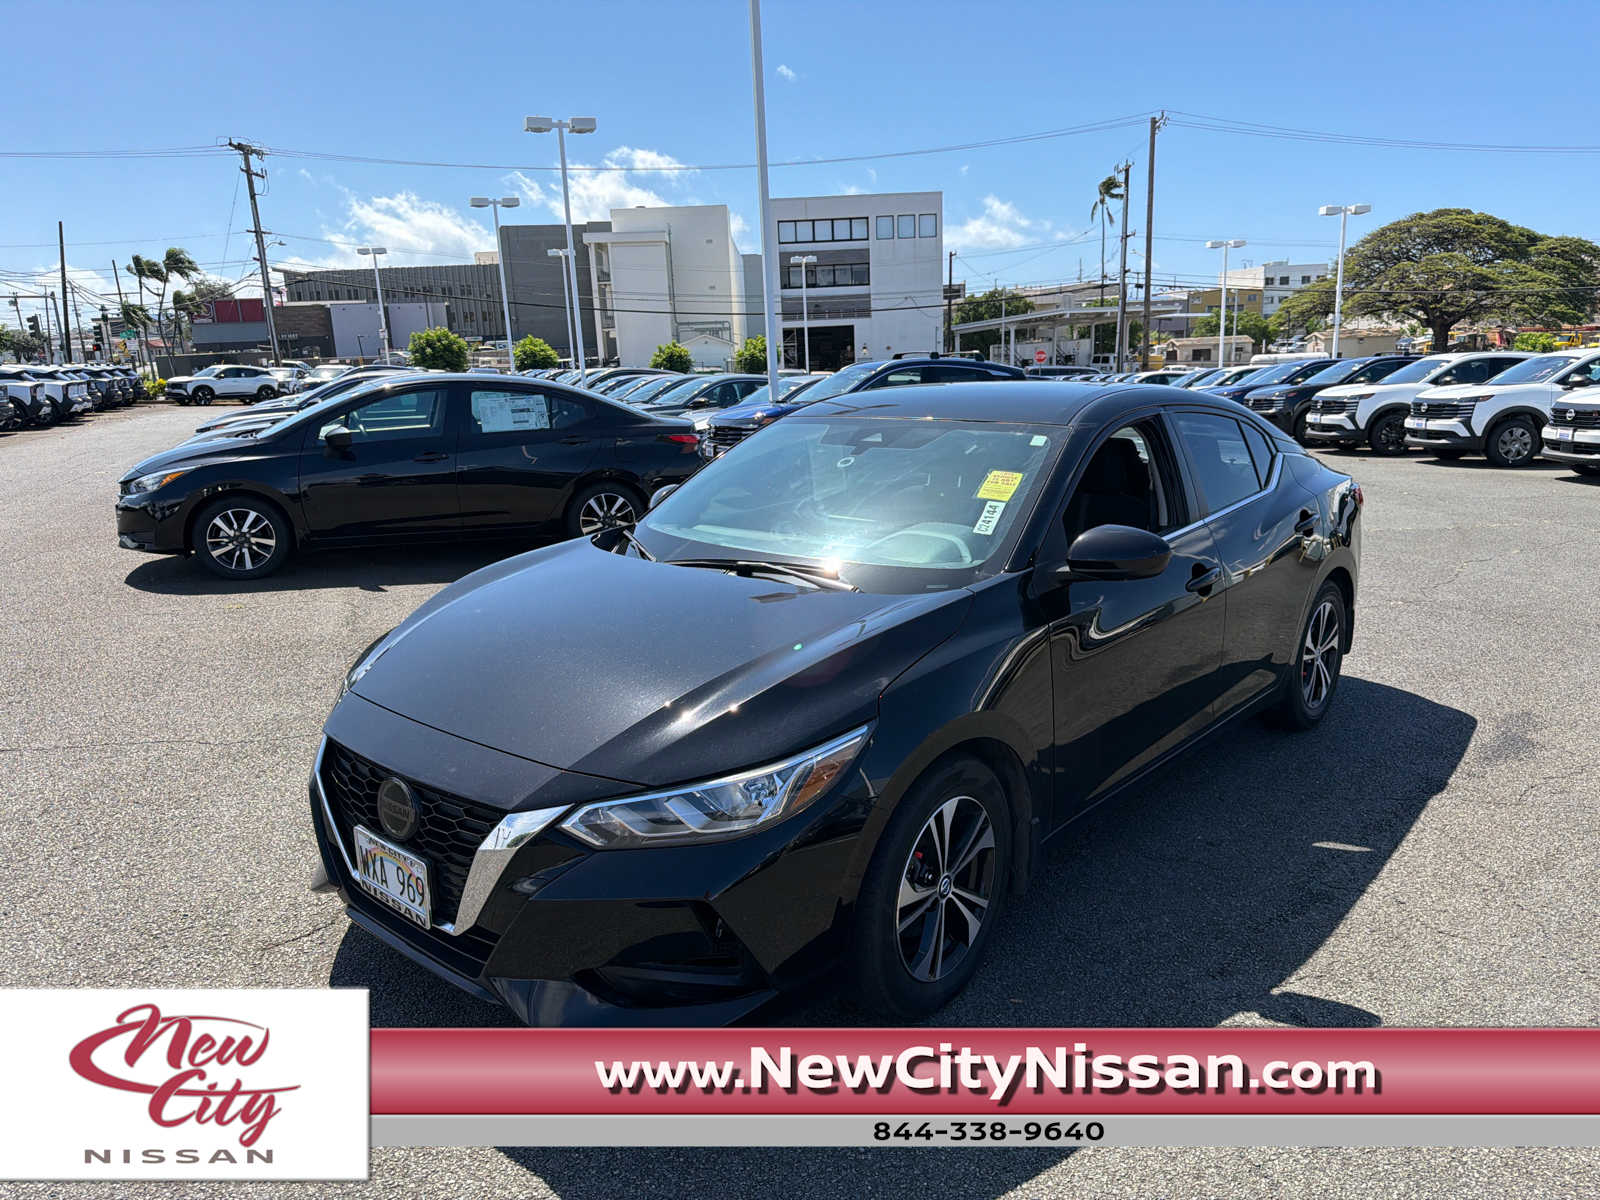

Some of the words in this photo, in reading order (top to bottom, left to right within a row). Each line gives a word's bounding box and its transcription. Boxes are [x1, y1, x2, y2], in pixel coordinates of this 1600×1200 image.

[360, 845, 389, 889] WXA
[396, 866, 425, 907] 969
[361, 880, 427, 927] NISSAN
